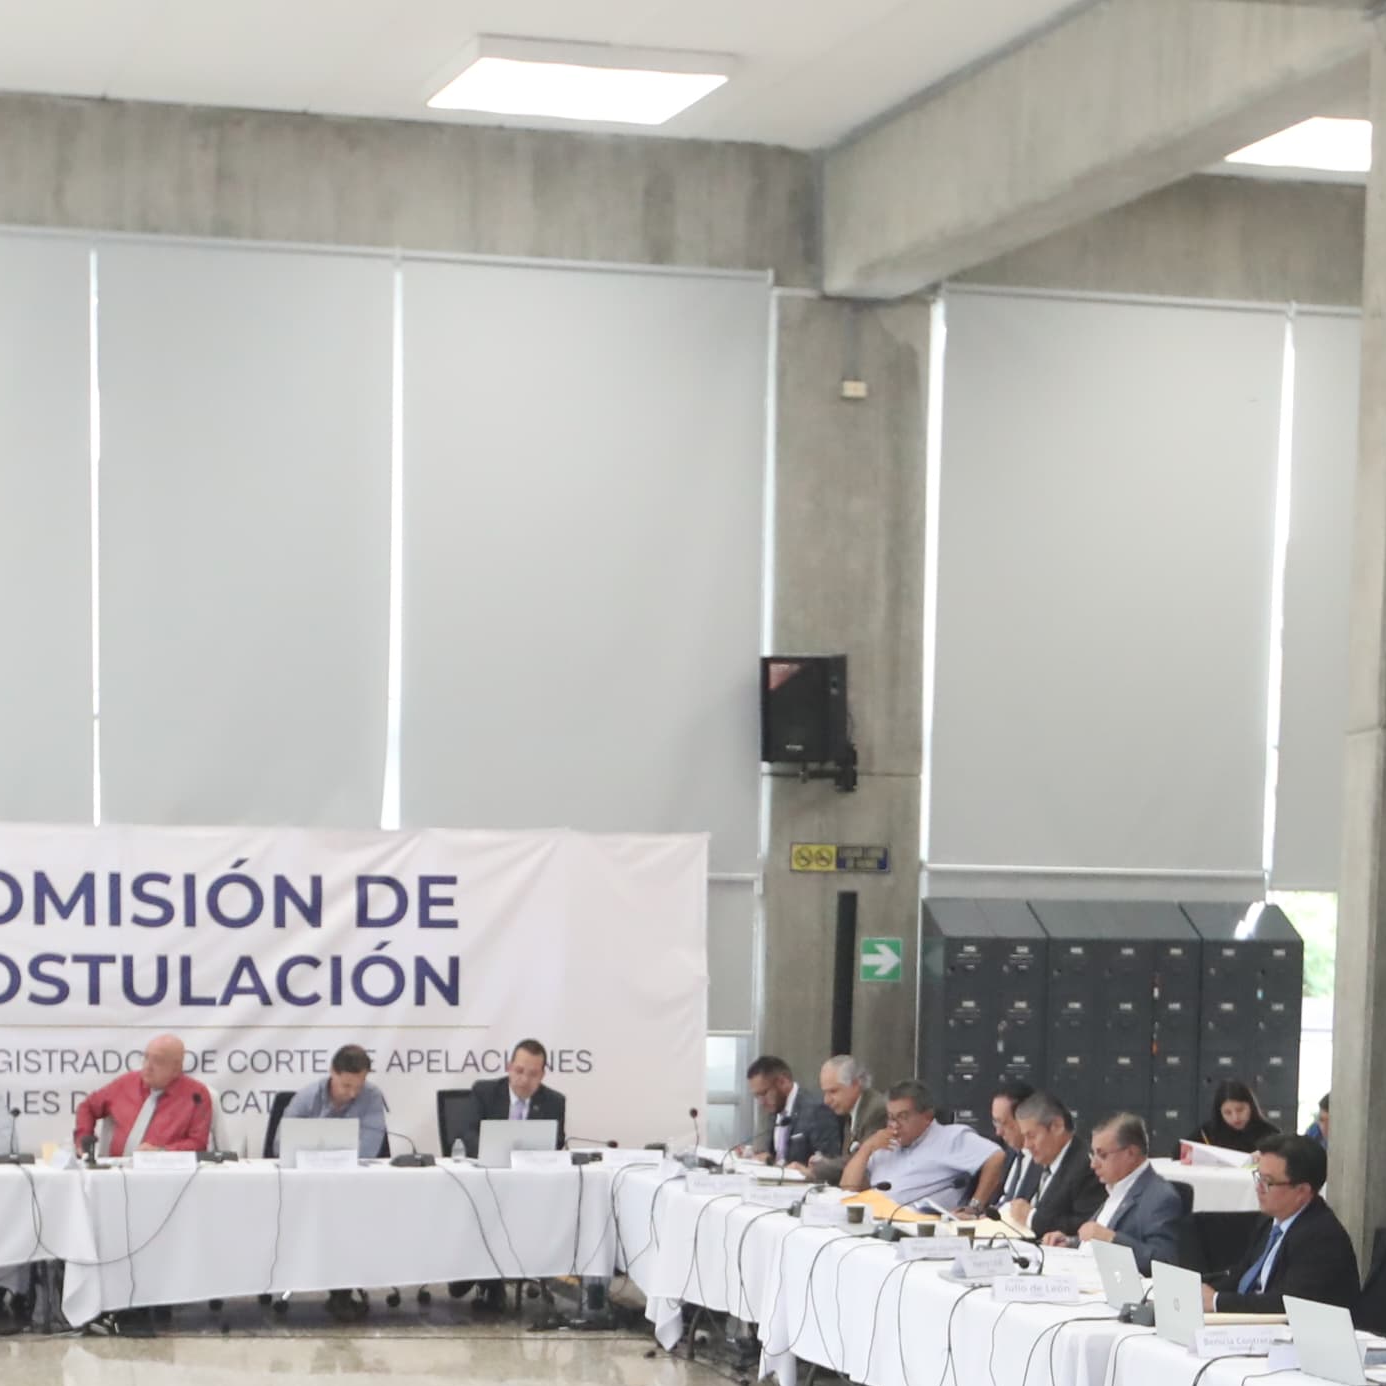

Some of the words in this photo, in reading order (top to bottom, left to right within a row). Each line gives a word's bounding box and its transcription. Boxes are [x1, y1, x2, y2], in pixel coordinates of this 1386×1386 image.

[355, 875, 459, 928] DE
[181, 1049, 218, 1074] DE
[227, 1048, 329, 1074] CORTE
[385, 1048, 593, 1074] APELACINES
